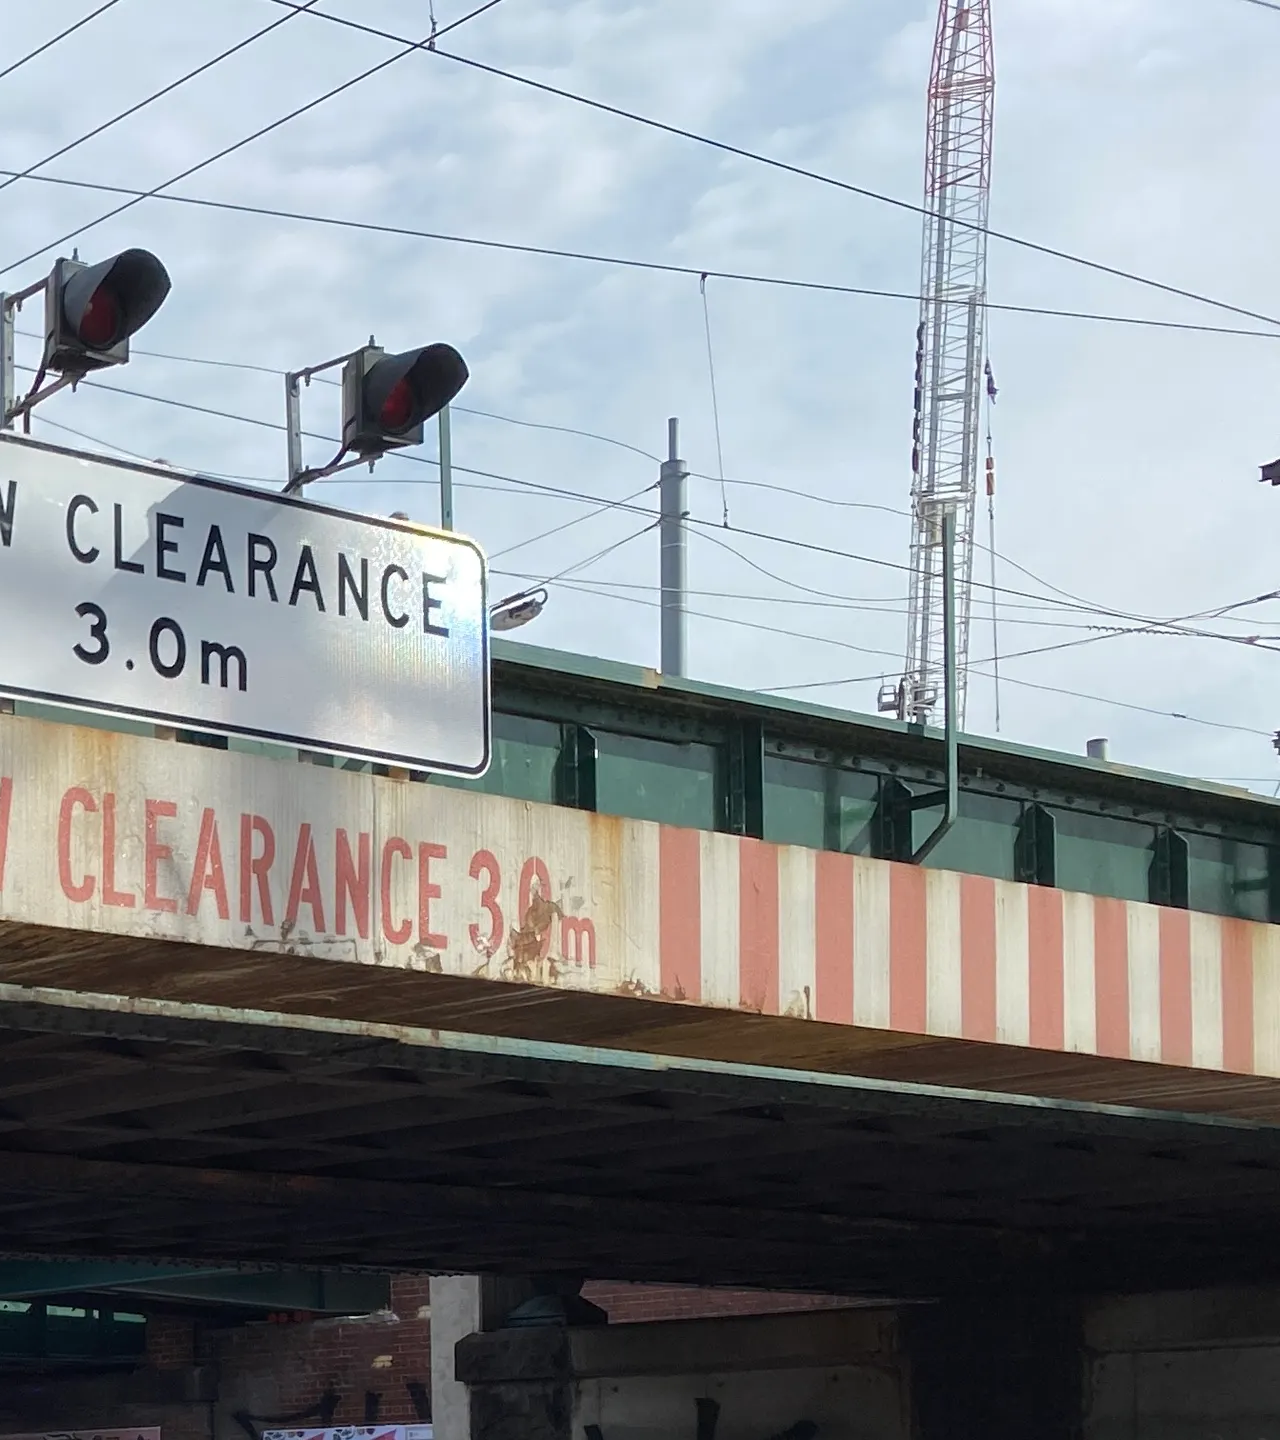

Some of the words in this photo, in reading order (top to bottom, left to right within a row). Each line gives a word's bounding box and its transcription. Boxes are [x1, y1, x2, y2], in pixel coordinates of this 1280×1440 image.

[66, 494, 450, 639] CLEARANCE
[72, 601, 248, 692] 3.0m
[57, 786, 448, 950] CLEARANCE
